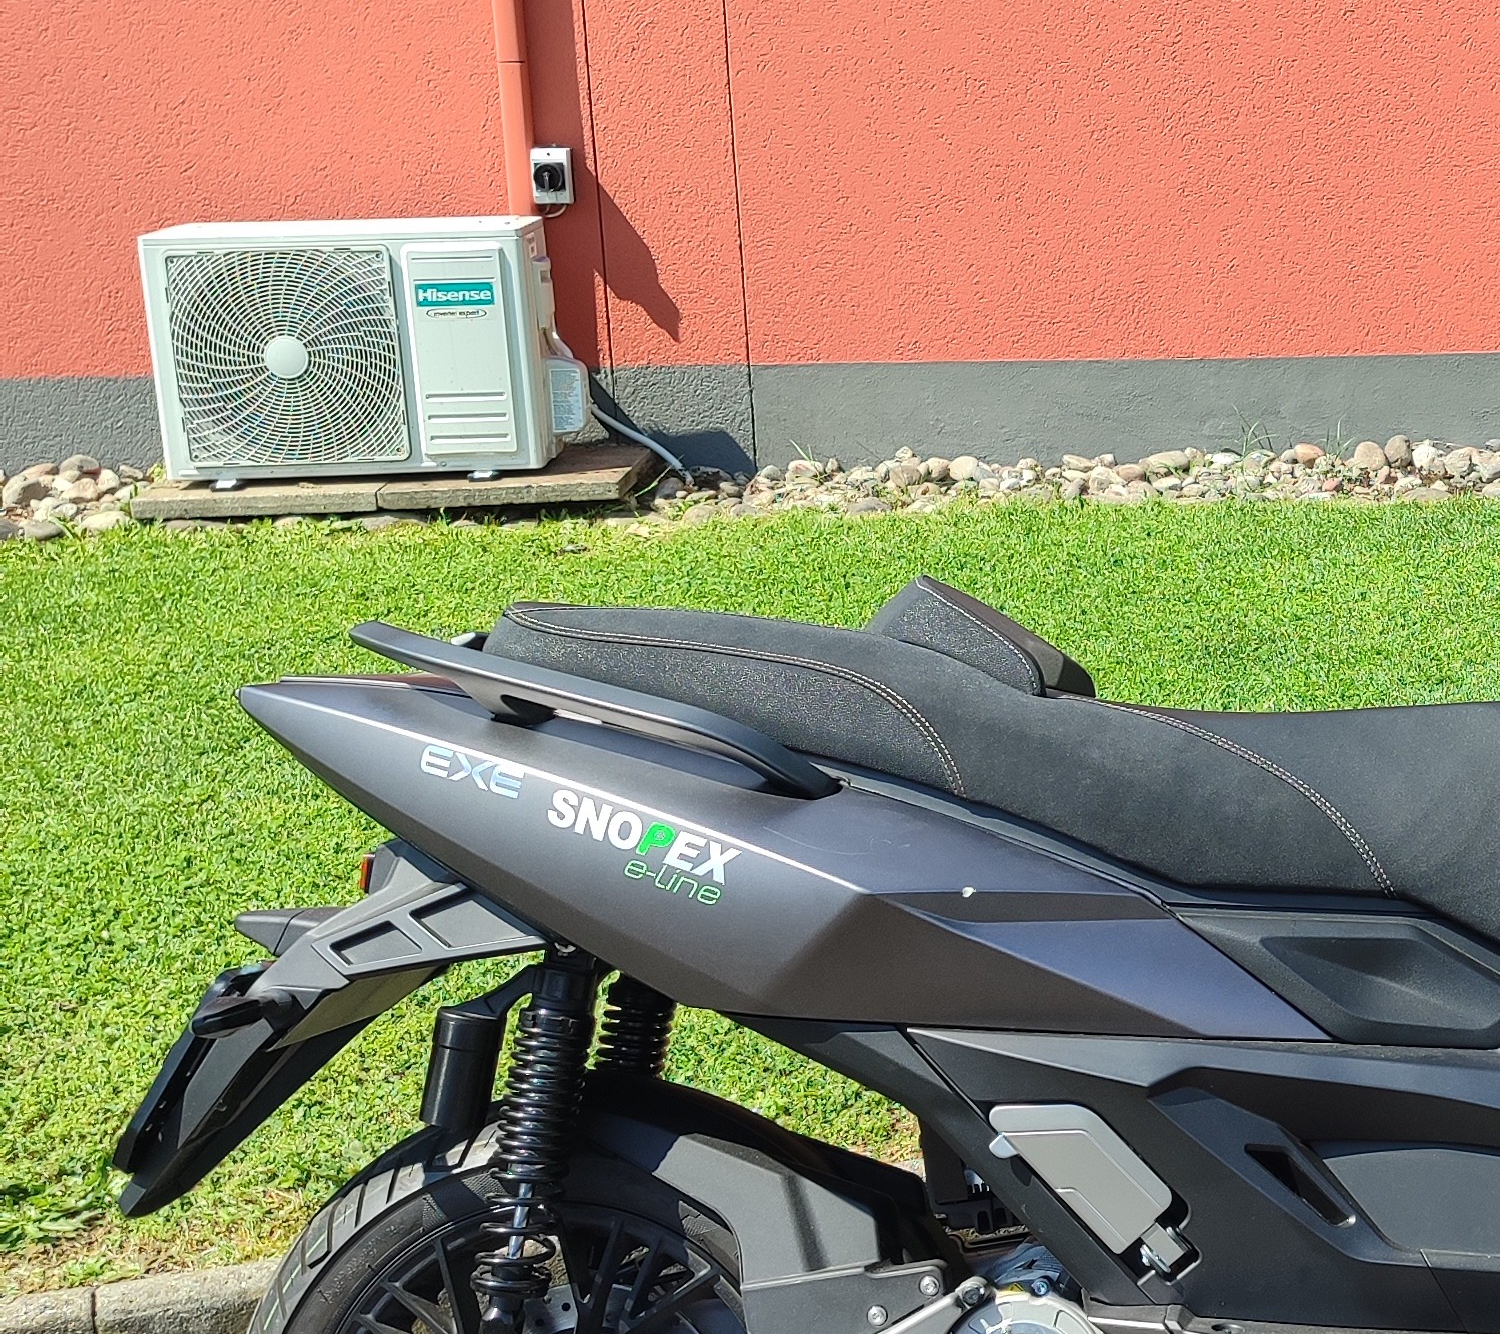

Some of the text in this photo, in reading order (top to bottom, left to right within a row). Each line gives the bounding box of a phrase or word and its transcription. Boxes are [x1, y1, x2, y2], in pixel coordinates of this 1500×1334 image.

[418, 288, 492, 302] Hisense
[420, 744, 526, 799] EXE
[547, 788, 743, 886] SNOPEX
[623, 857, 723, 906] e-line
